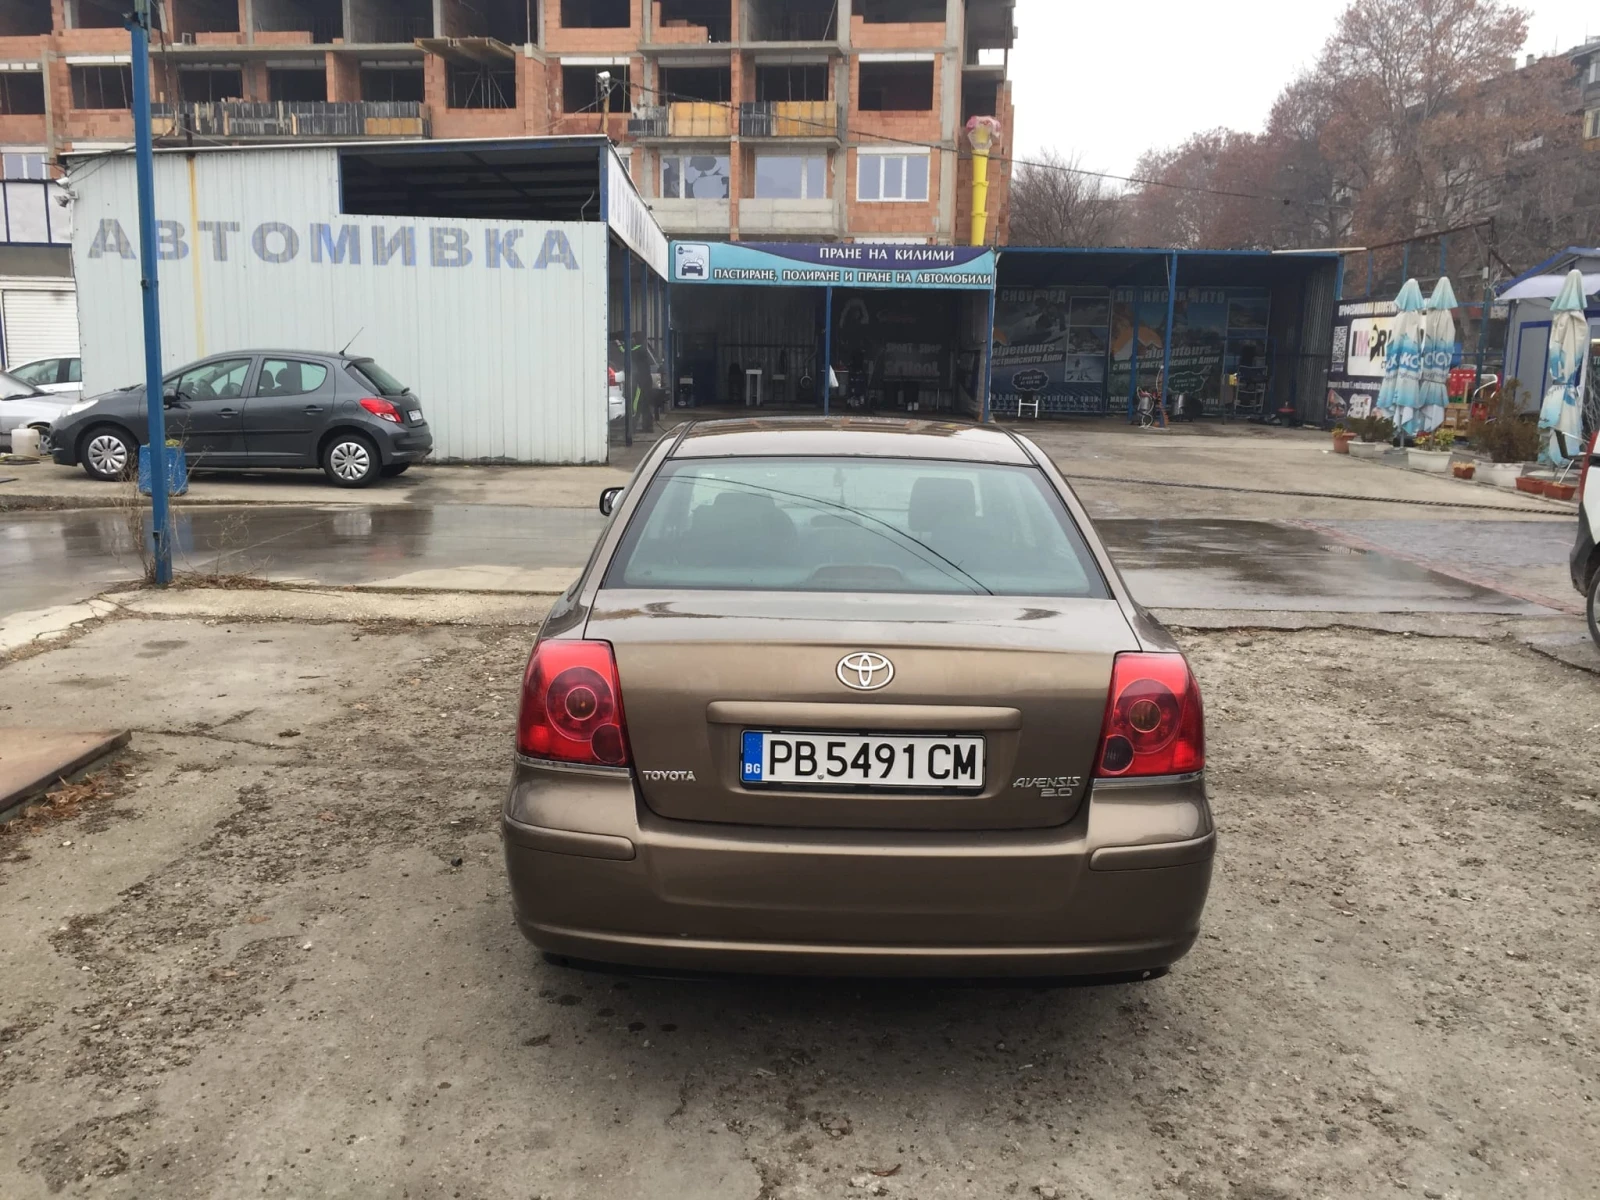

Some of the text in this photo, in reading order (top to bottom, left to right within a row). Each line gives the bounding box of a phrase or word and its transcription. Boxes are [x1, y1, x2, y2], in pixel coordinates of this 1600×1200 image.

[88, 218, 580, 270] АВТОМИВКА
[819, 247, 955, 262] ПРАНЕ НА КИЛИМИ
[713, 268, 992, 285] ПАСТИРАНЕ, ПОЛИРАНЕ И ПРАНЕ НА АВТОМОБИЛИ
[1145, 345, 1212, 359] alpntours
[744, 763, 762, 776] BG
[643, 770, 696, 783] TOYOTA
[1012, 776, 1081, 788] AVENSIS
[1040, 787, 1074, 797] 2.0
